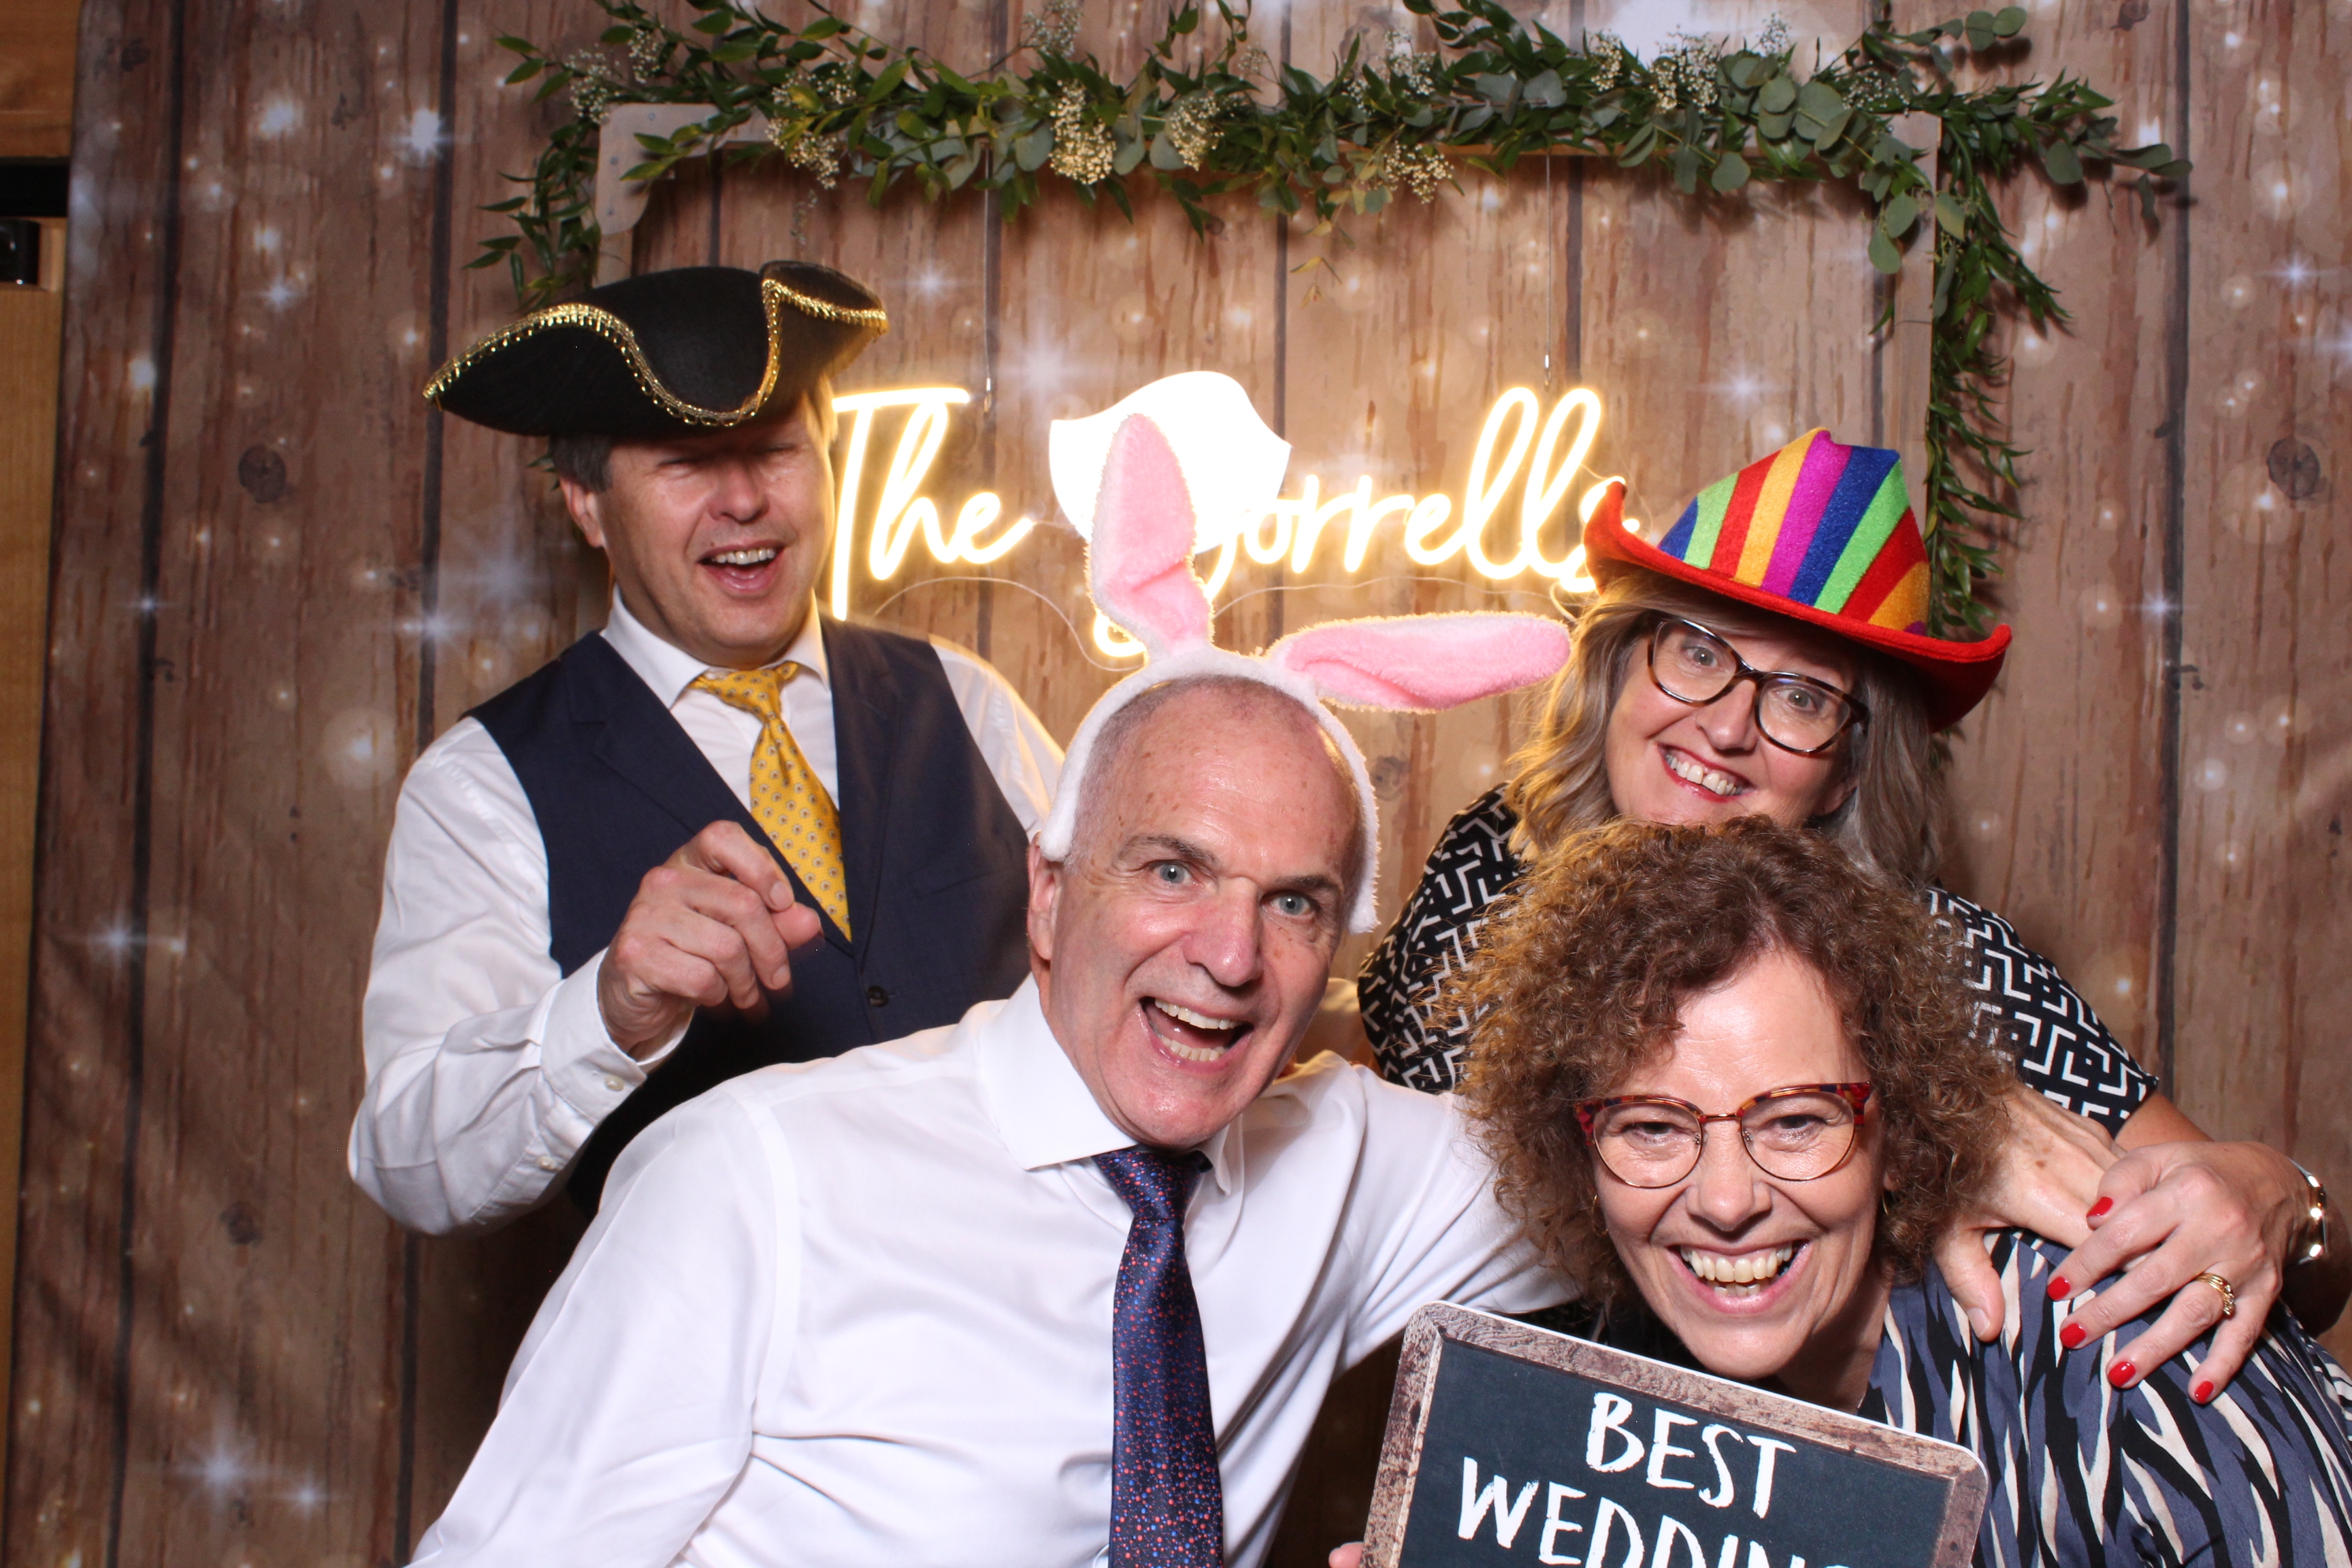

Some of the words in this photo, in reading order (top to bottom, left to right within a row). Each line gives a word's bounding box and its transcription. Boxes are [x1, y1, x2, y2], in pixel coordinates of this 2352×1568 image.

[831, 386, 1037, 621] The
[1093, 386, 1641, 658] orrell
[1457, 1456, 1850, 1568] WEDD
[1585, 1392, 1797, 1520] BEST
